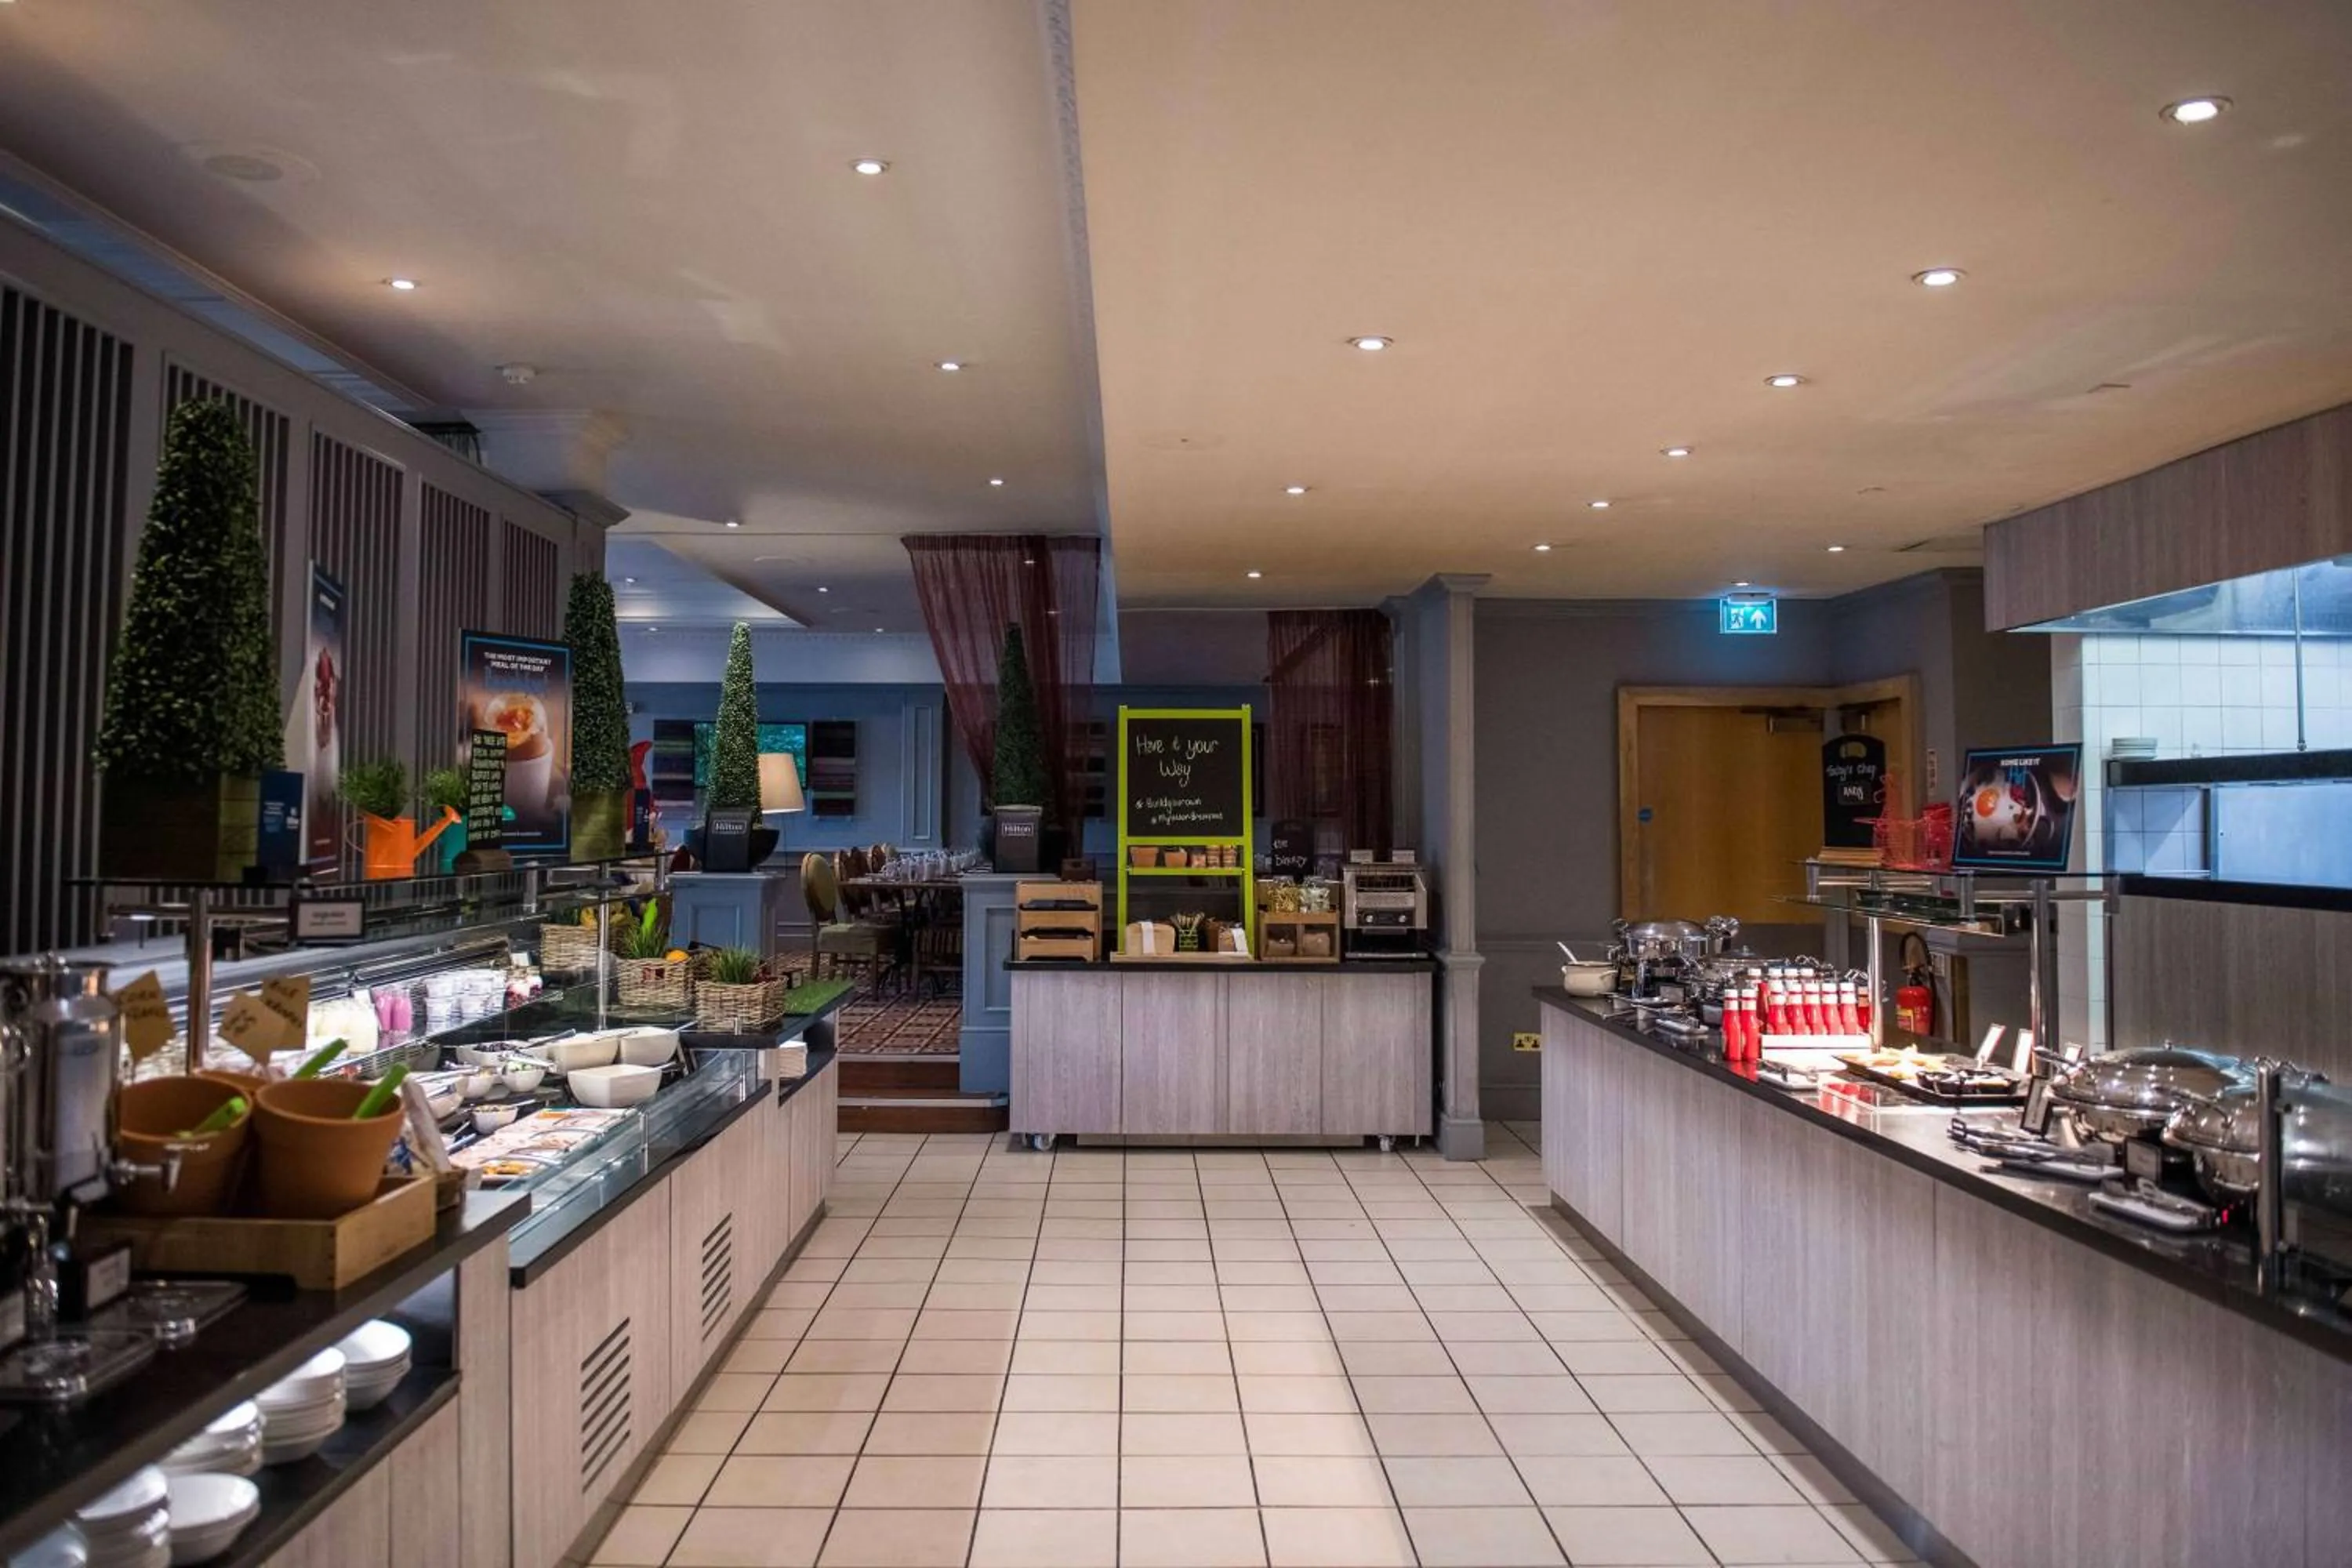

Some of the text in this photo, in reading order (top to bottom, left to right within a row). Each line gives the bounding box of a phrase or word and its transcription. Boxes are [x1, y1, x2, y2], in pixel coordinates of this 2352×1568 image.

[1135, 734, 1165, 757] Have
[1185, 739, 1220, 760] your
[1160, 758, 1191, 788] Way
[716, 822, 743, 831] Hilton
